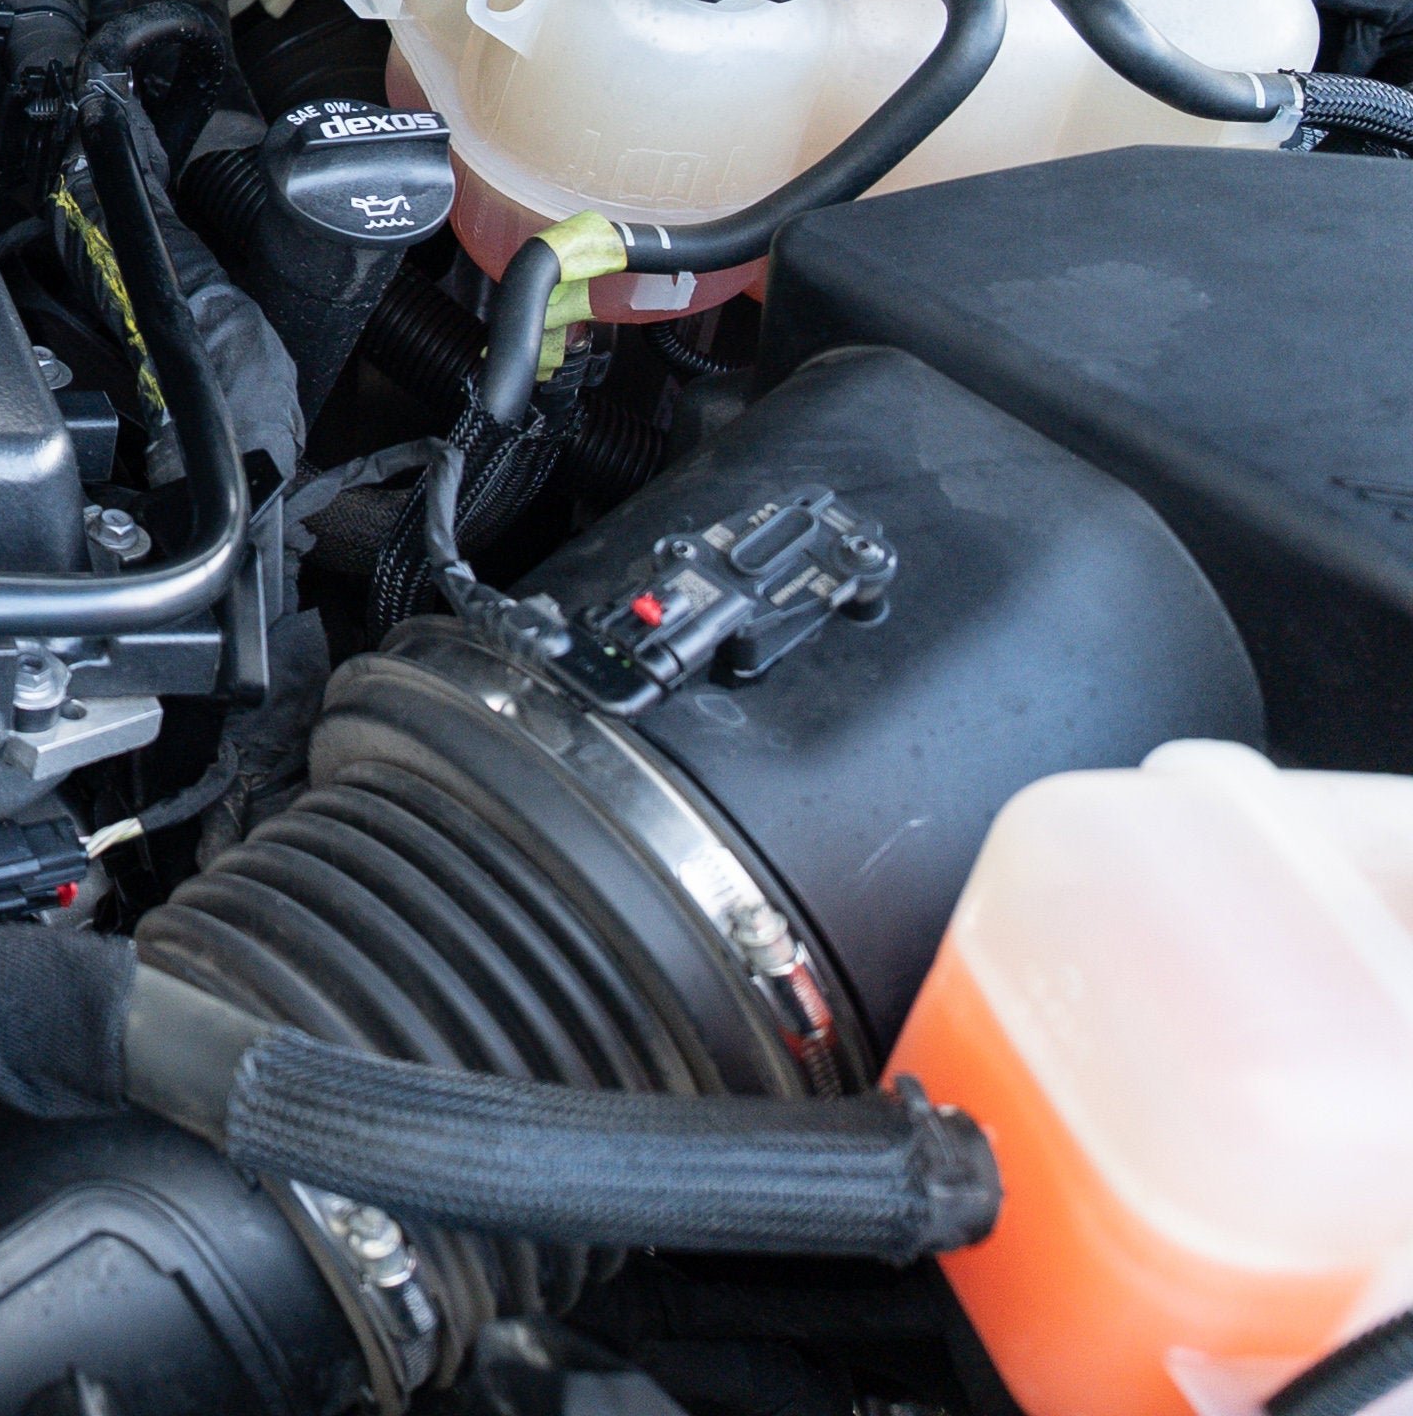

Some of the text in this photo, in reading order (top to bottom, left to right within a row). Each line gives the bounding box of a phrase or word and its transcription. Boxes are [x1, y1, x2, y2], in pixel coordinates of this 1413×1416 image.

[286, 101, 368, 126] SAE 0W-
[319, 113, 439, 139] dexos
